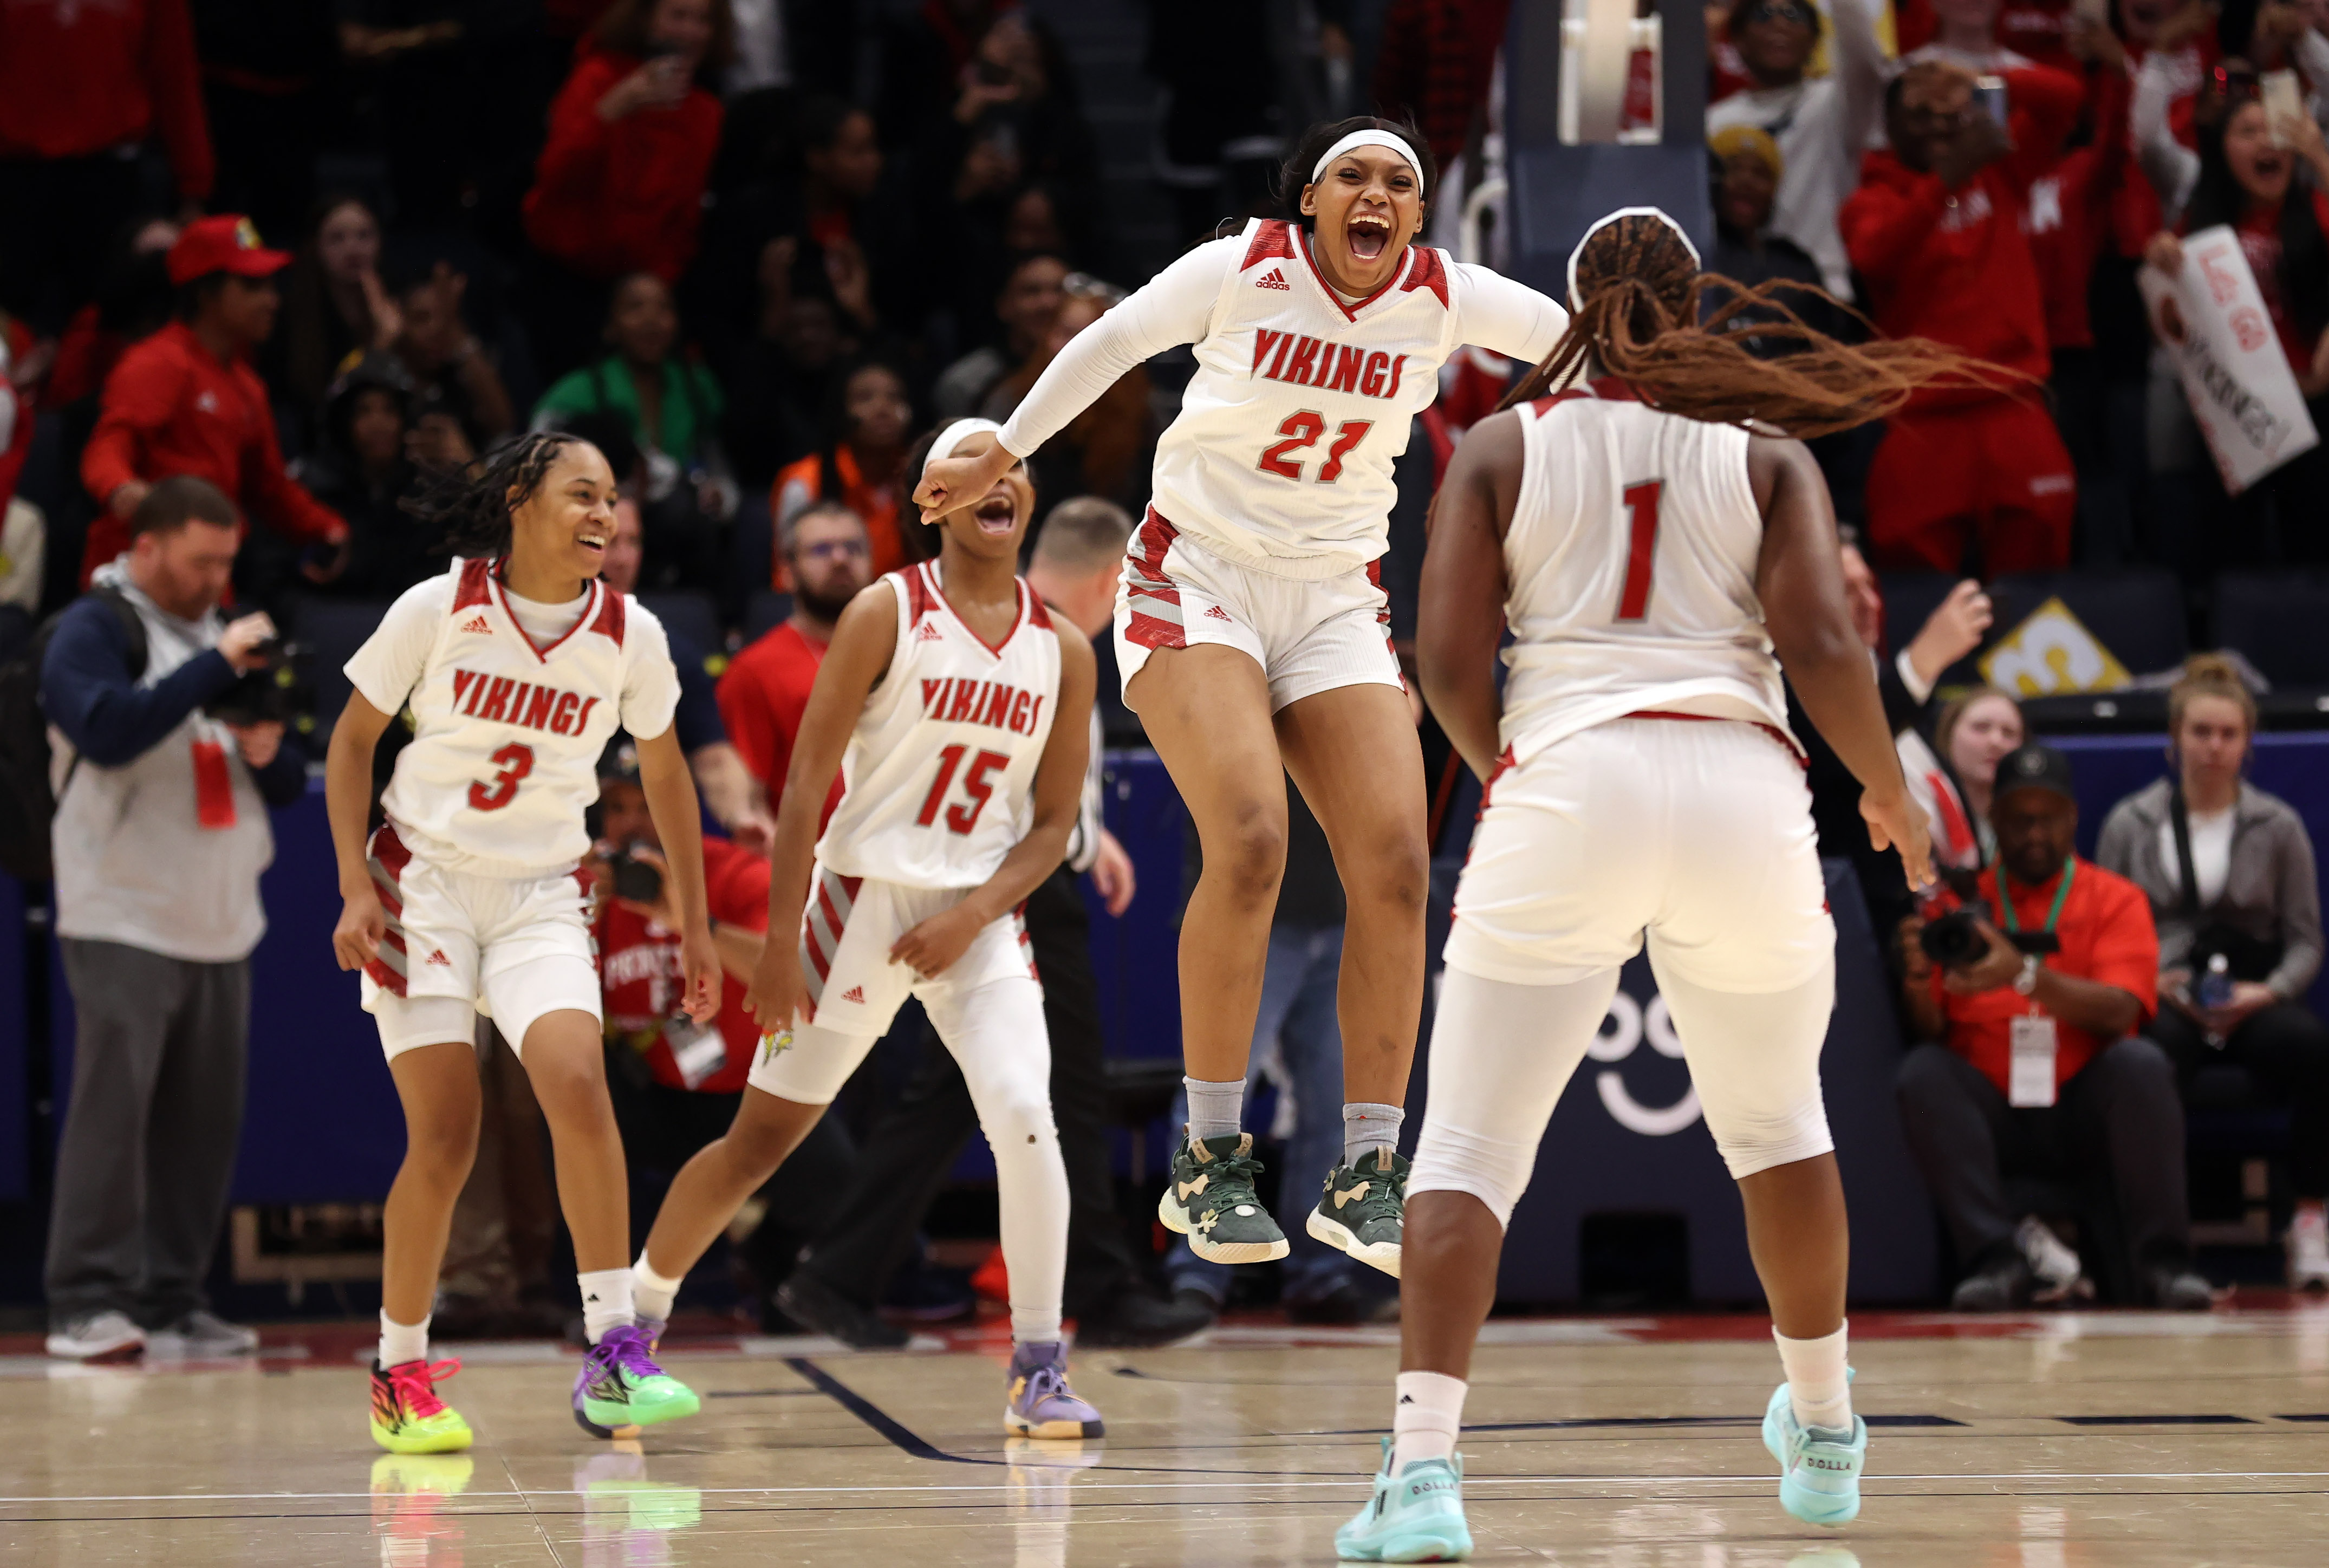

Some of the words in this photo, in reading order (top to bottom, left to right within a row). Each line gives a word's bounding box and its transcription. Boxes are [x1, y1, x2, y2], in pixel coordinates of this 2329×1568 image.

[1255, 280, 1290, 291] adidas
[1250, 328, 1411, 400] VIKINGS
[1255, 408, 1376, 485] 21
[1612, 477, 1666, 624] 1
[1203, 612, 1233, 623] adidas
[451, 668, 602, 737] VIKINGS
[920, 677, 1045, 737] VIKINGS
[467, 741, 535, 812] 3
[916, 743, 1011, 836] 15
